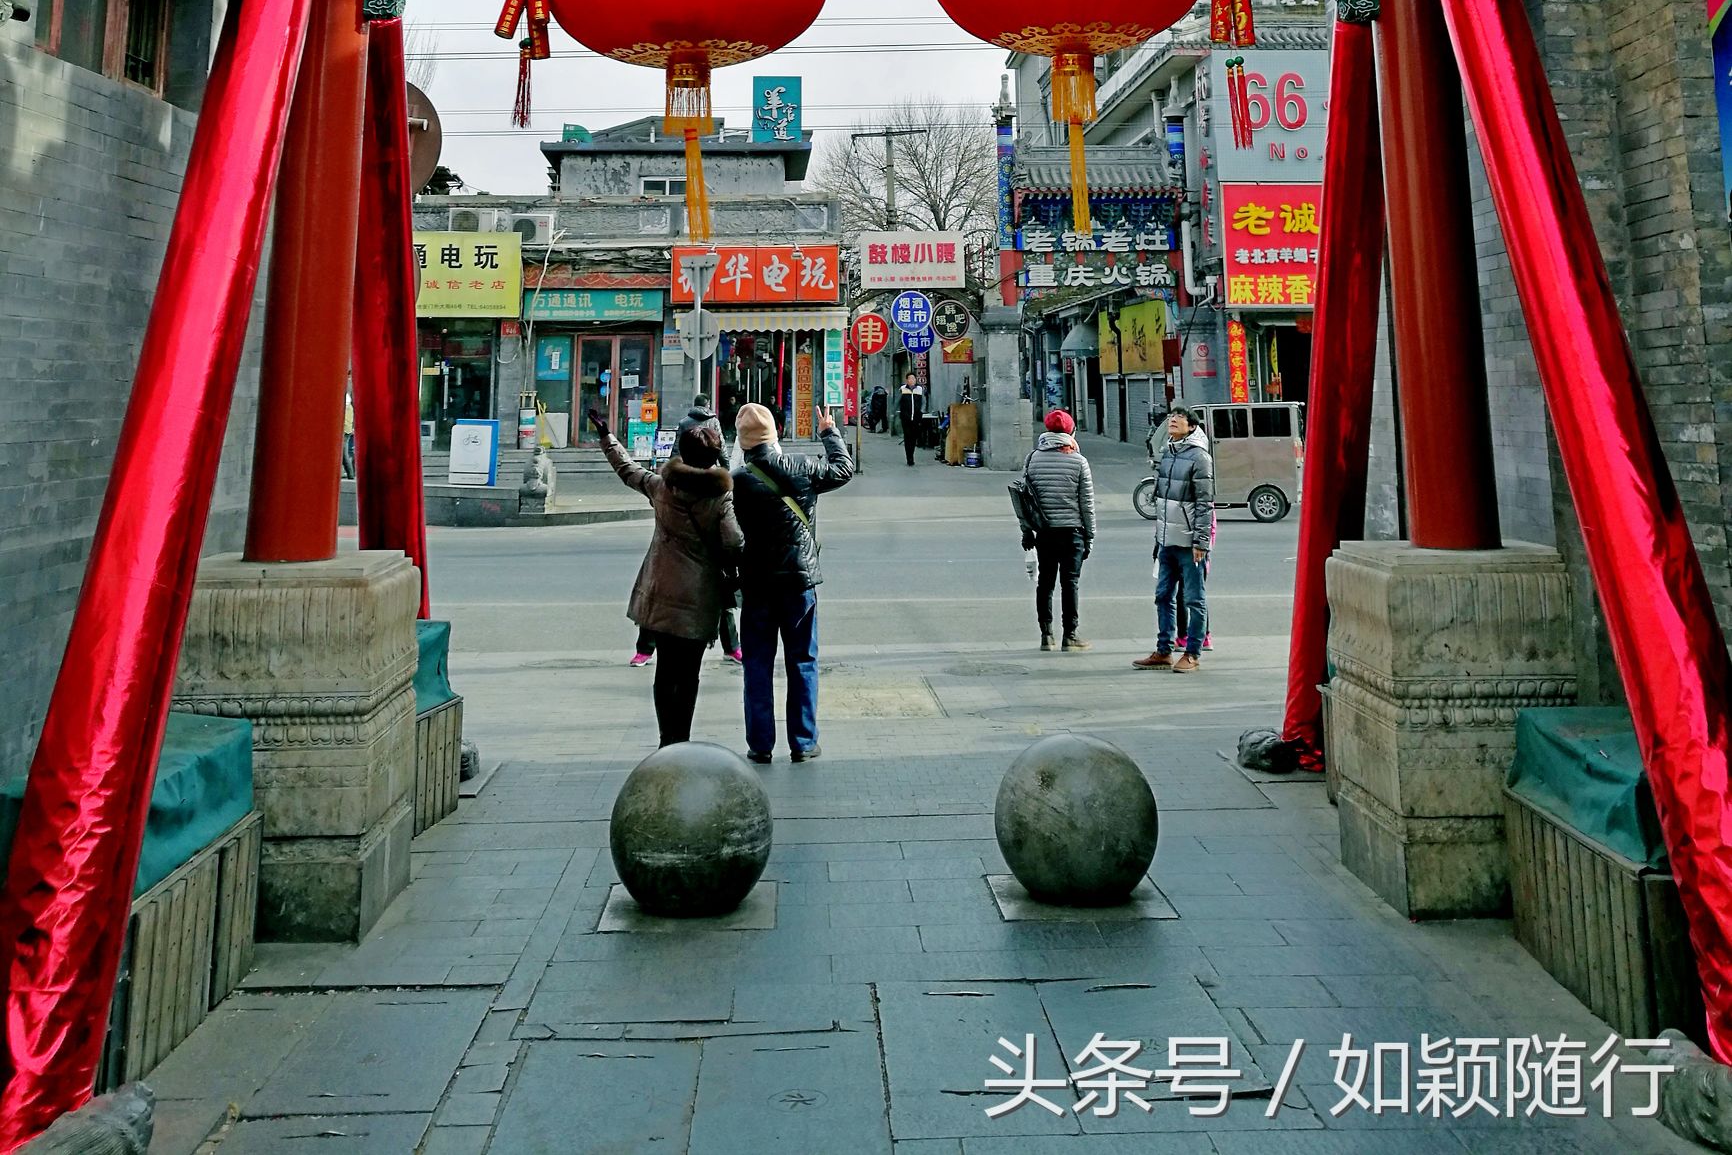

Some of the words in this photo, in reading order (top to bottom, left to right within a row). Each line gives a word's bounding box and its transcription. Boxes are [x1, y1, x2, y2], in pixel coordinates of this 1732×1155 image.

[1244, 72, 1308, 131] 66
[1026, 229, 1170, 251] 老锅老灶
[868, 243, 956, 264] 鼓楼小腰
[424, 279, 507, 290] 诚信老店
[678, 253, 835, 296] 华电玩
[1026, 264, 1172, 287] 重庆火锅
[615, 293, 644, 307] 电玩
[1229, 274, 1317, 306] 麻辣香
[899, 297, 924, 309] 烟酒
[897, 310, 927, 322] 超市
[857, 318, 883, 350] 串
[908, 336, 931, 348] 超市
